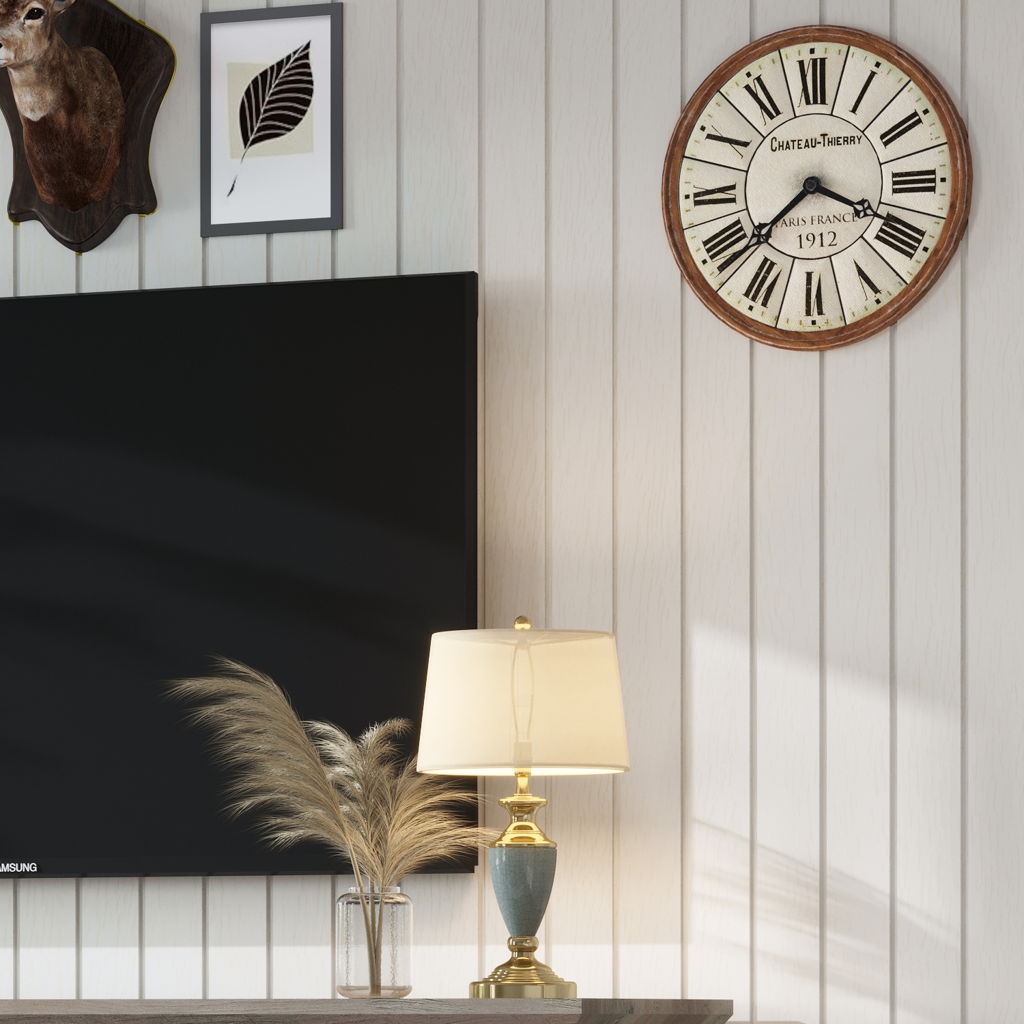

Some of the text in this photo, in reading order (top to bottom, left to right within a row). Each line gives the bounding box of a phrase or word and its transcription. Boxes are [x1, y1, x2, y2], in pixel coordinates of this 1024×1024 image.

[743, 74, 783, 126] XI
[797, 57, 828, 107] XII
[705, 124, 752, 159] X
[880, 109, 924, 149] II
[693, 183, 737, 206] IX
[892, 168, 936, 195] III
[796, 231, 838, 250] 1912
[743, 254, 783, 309] VII
[805, 271, 826, 317] VI
[853, 259, 883, 301] V
